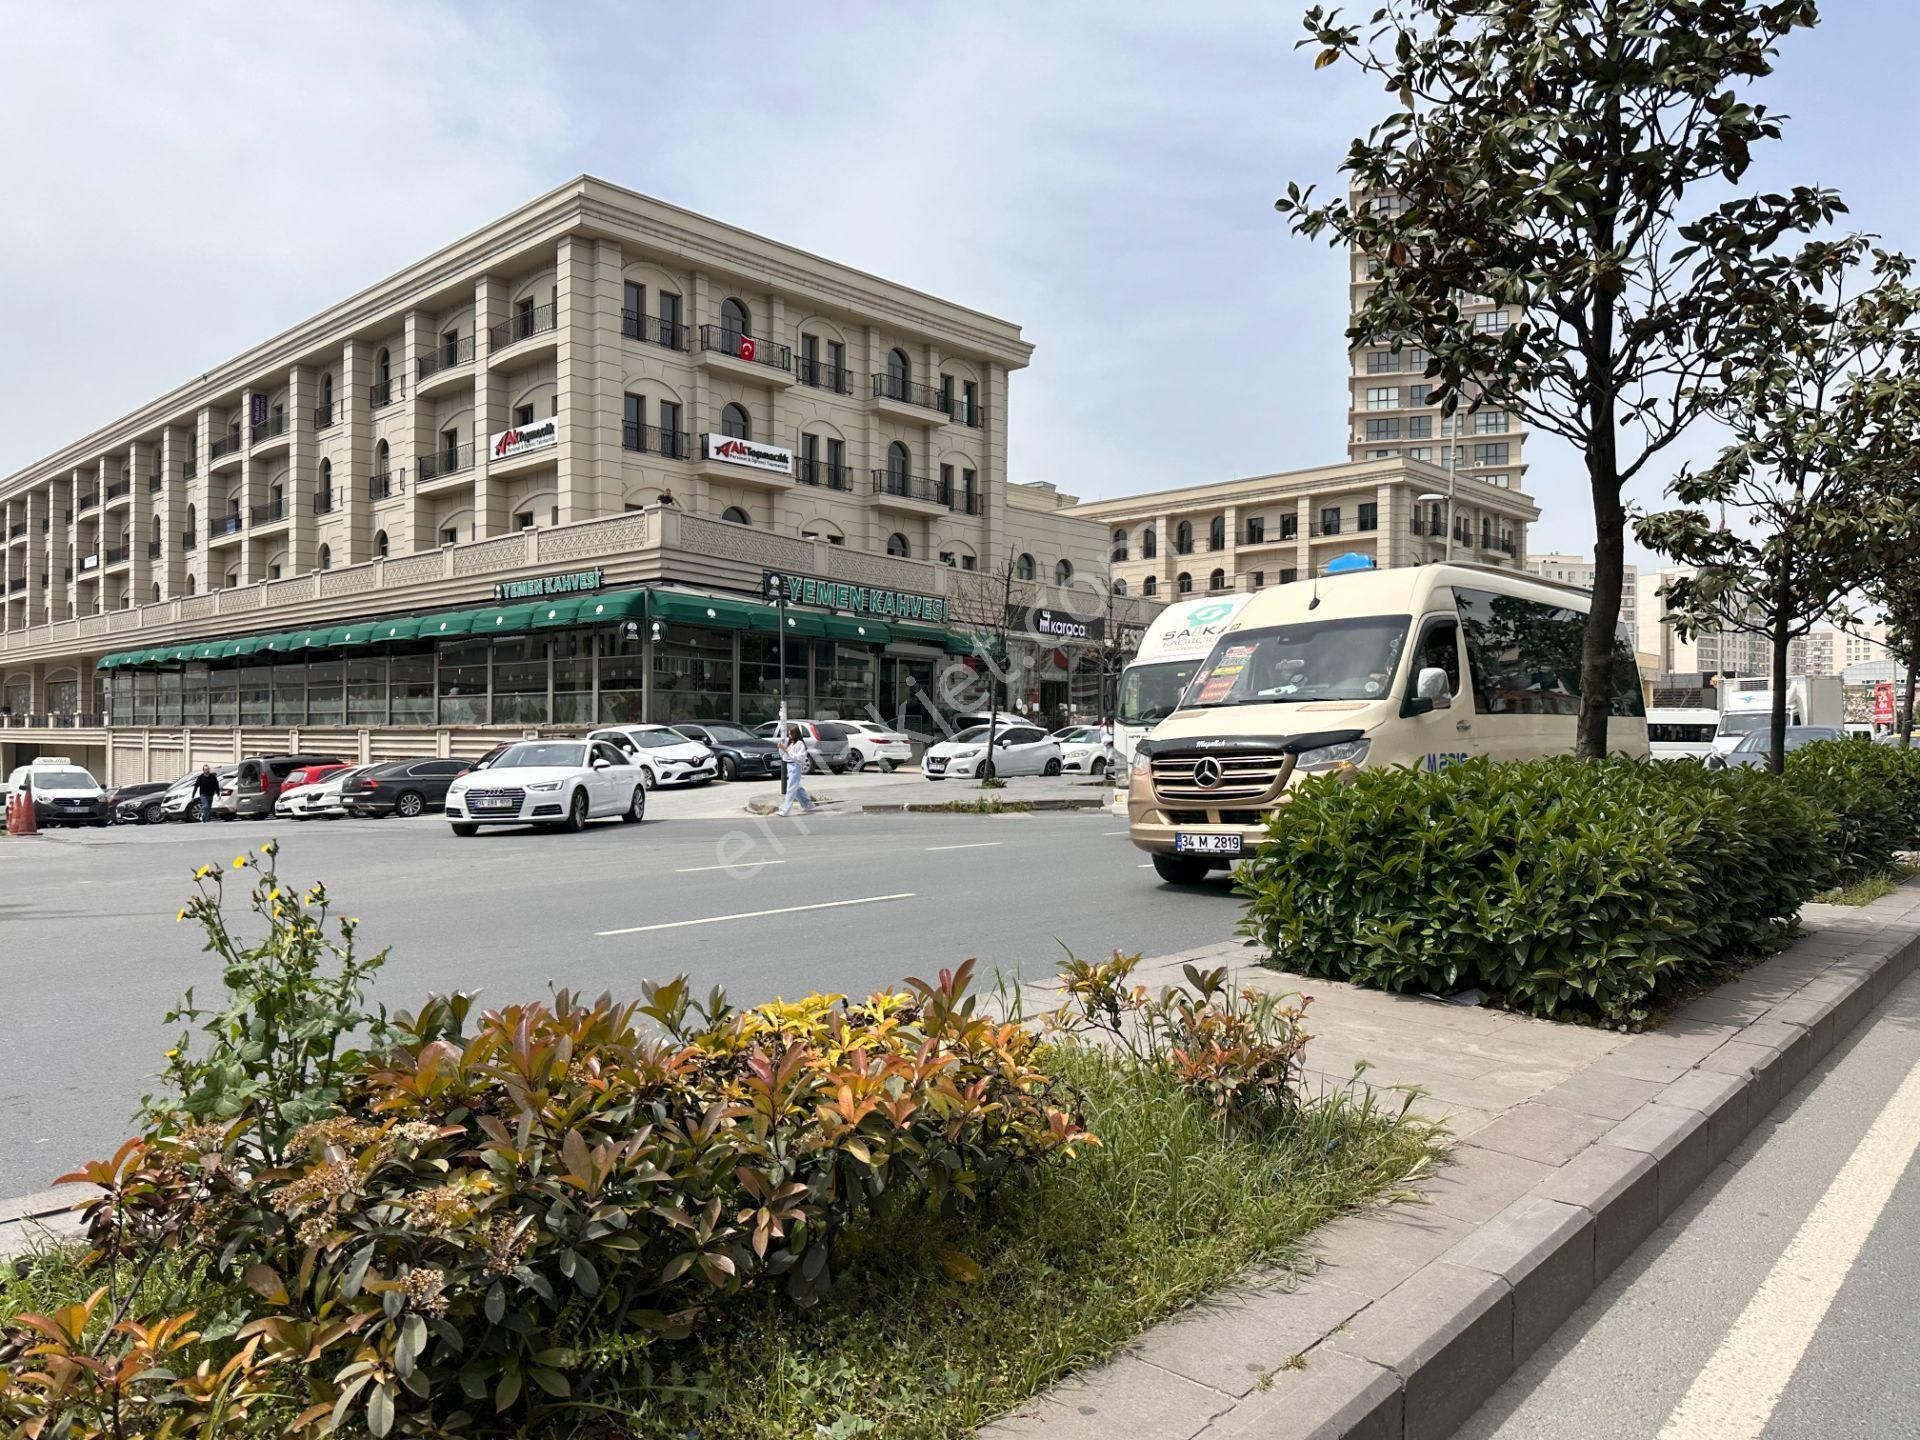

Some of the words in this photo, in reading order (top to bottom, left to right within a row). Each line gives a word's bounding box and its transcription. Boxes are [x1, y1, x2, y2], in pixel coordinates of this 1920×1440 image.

[503, 579, 544, 599] YEMEN
[786, 575, 865, 612] YEMEN
[1050, 620, 1086, 637] karaca
[1182, 835, 1194, 848] 34
[1199, 836, 1208, 848] M
[1214, 836, 1239, 849] 2819
